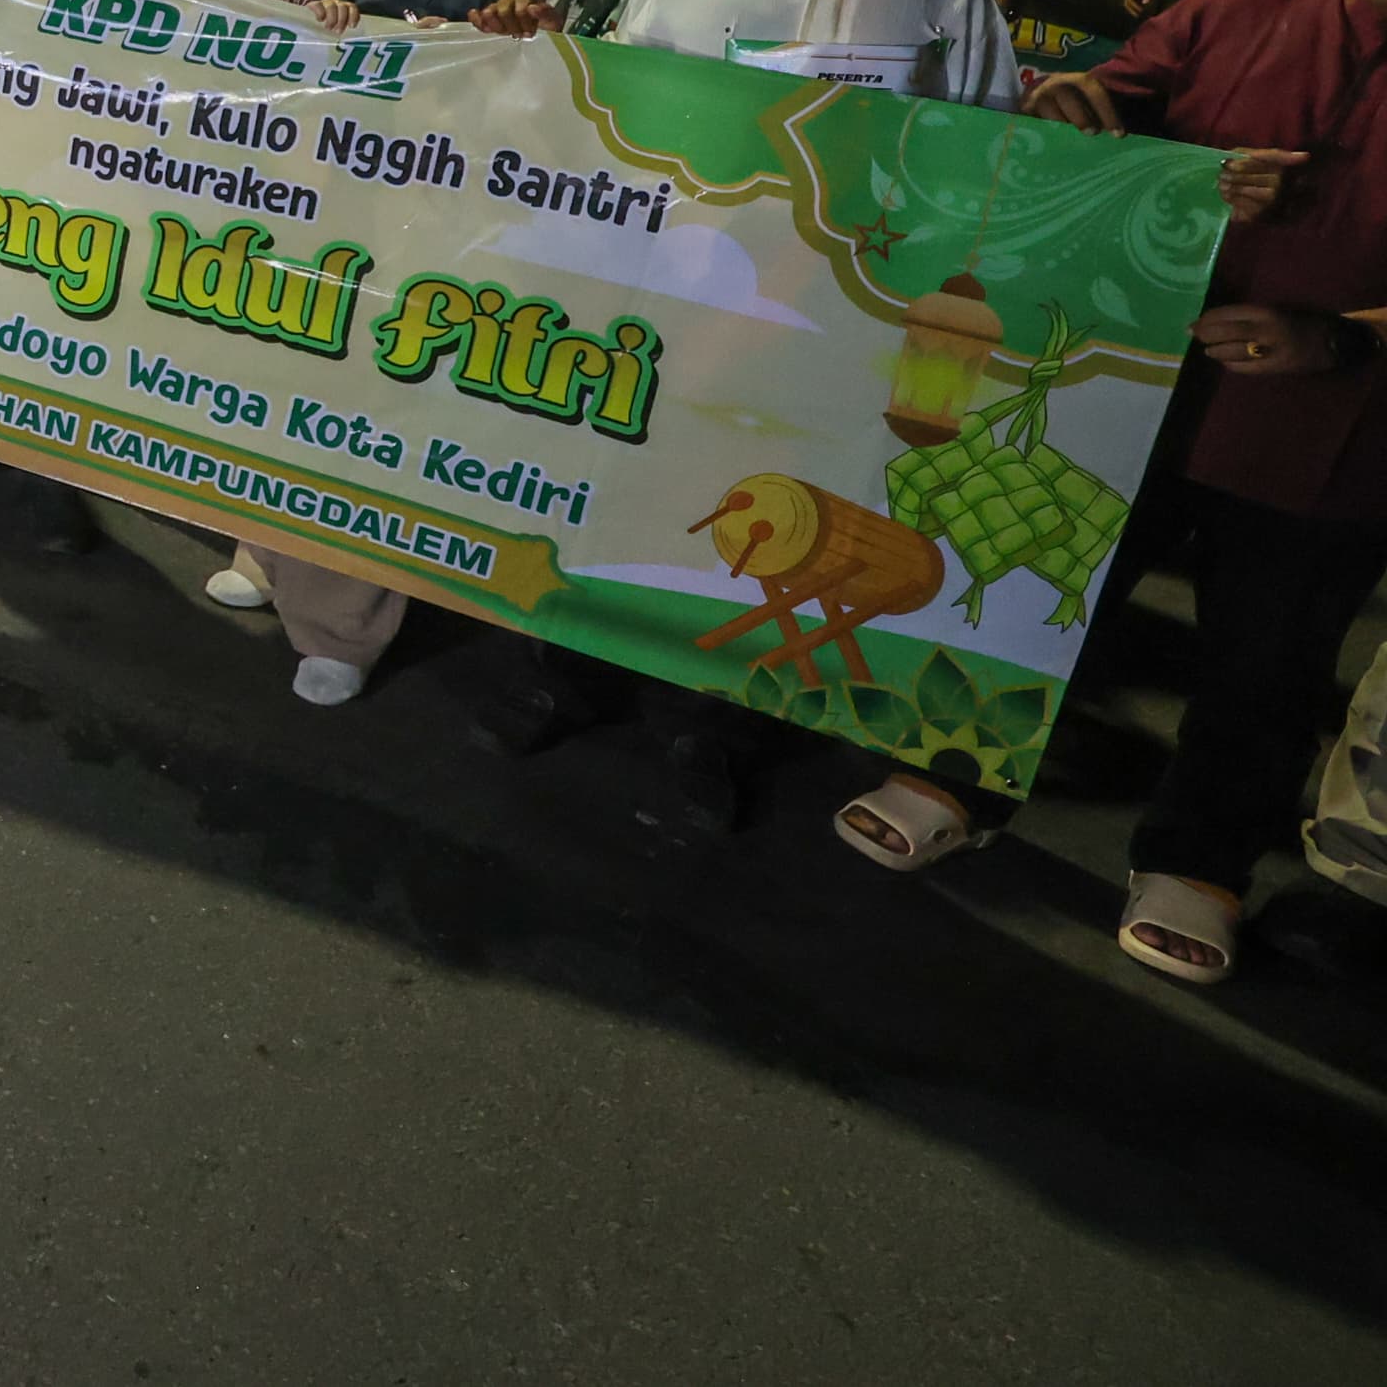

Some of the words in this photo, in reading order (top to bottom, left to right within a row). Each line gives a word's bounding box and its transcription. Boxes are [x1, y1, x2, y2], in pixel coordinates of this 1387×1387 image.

[184, 11, 308, 81] NO.
[320, 39, 418, 101] 11
[816, 72, 884, 84] PESERTA
[57, 66, 169, 137] Jawi,
[190, 92, 298, 154] Kulo
[316, 118, 465, 189] Nggih
[488, 149, 671, 233] Santri
[70, 134, 319, 221] ngaturaken
[145, 213, 368, 352] Idul
[90, 422, 493, 577] KAMPUNGDALEM
[128, 347, 269, 427] Warga
[285, 398, 403, 468] Kota
[427, 437, 591, 526] Kediri
